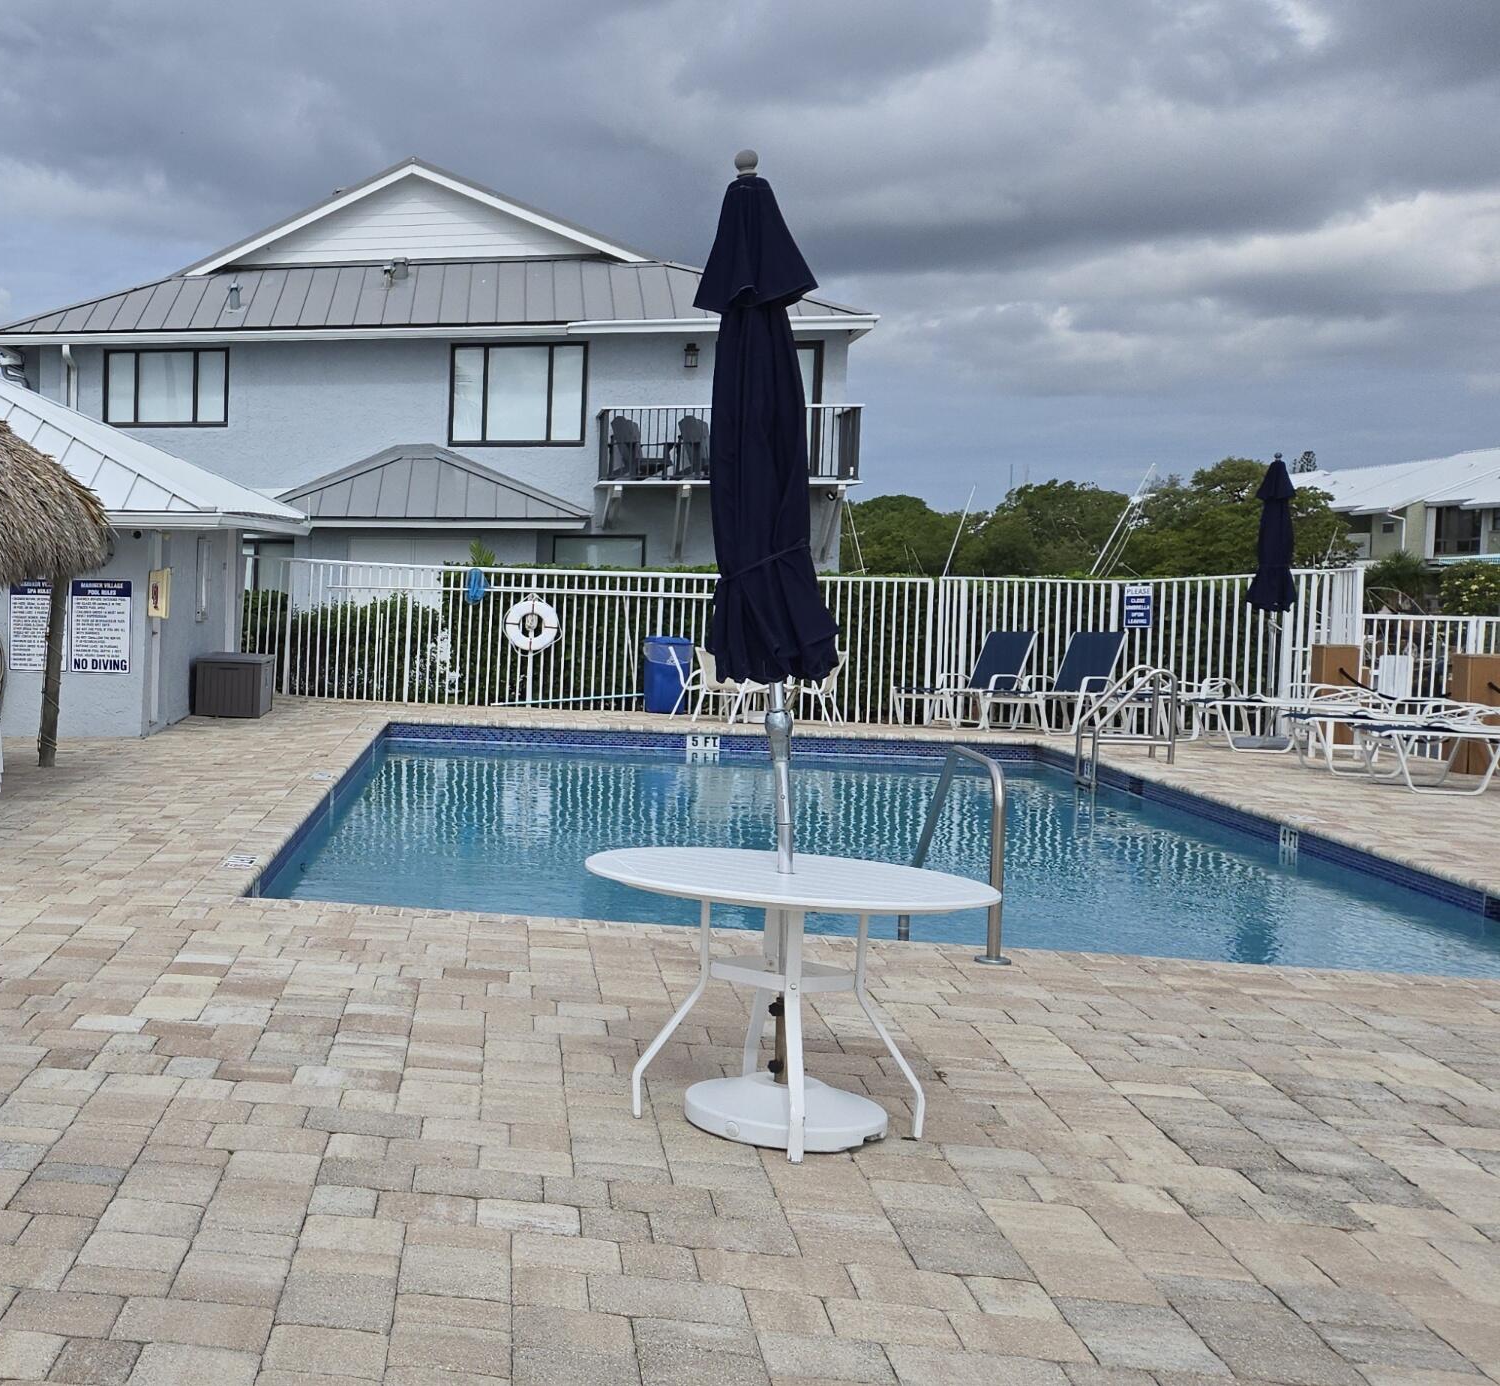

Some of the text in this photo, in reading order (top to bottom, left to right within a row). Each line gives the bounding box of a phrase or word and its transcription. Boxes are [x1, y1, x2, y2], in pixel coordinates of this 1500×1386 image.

[73, 658, 128, 671] NO DIVING
[691, 736, 699, 747] 5
[1282, 829, 1287, 845] 4
